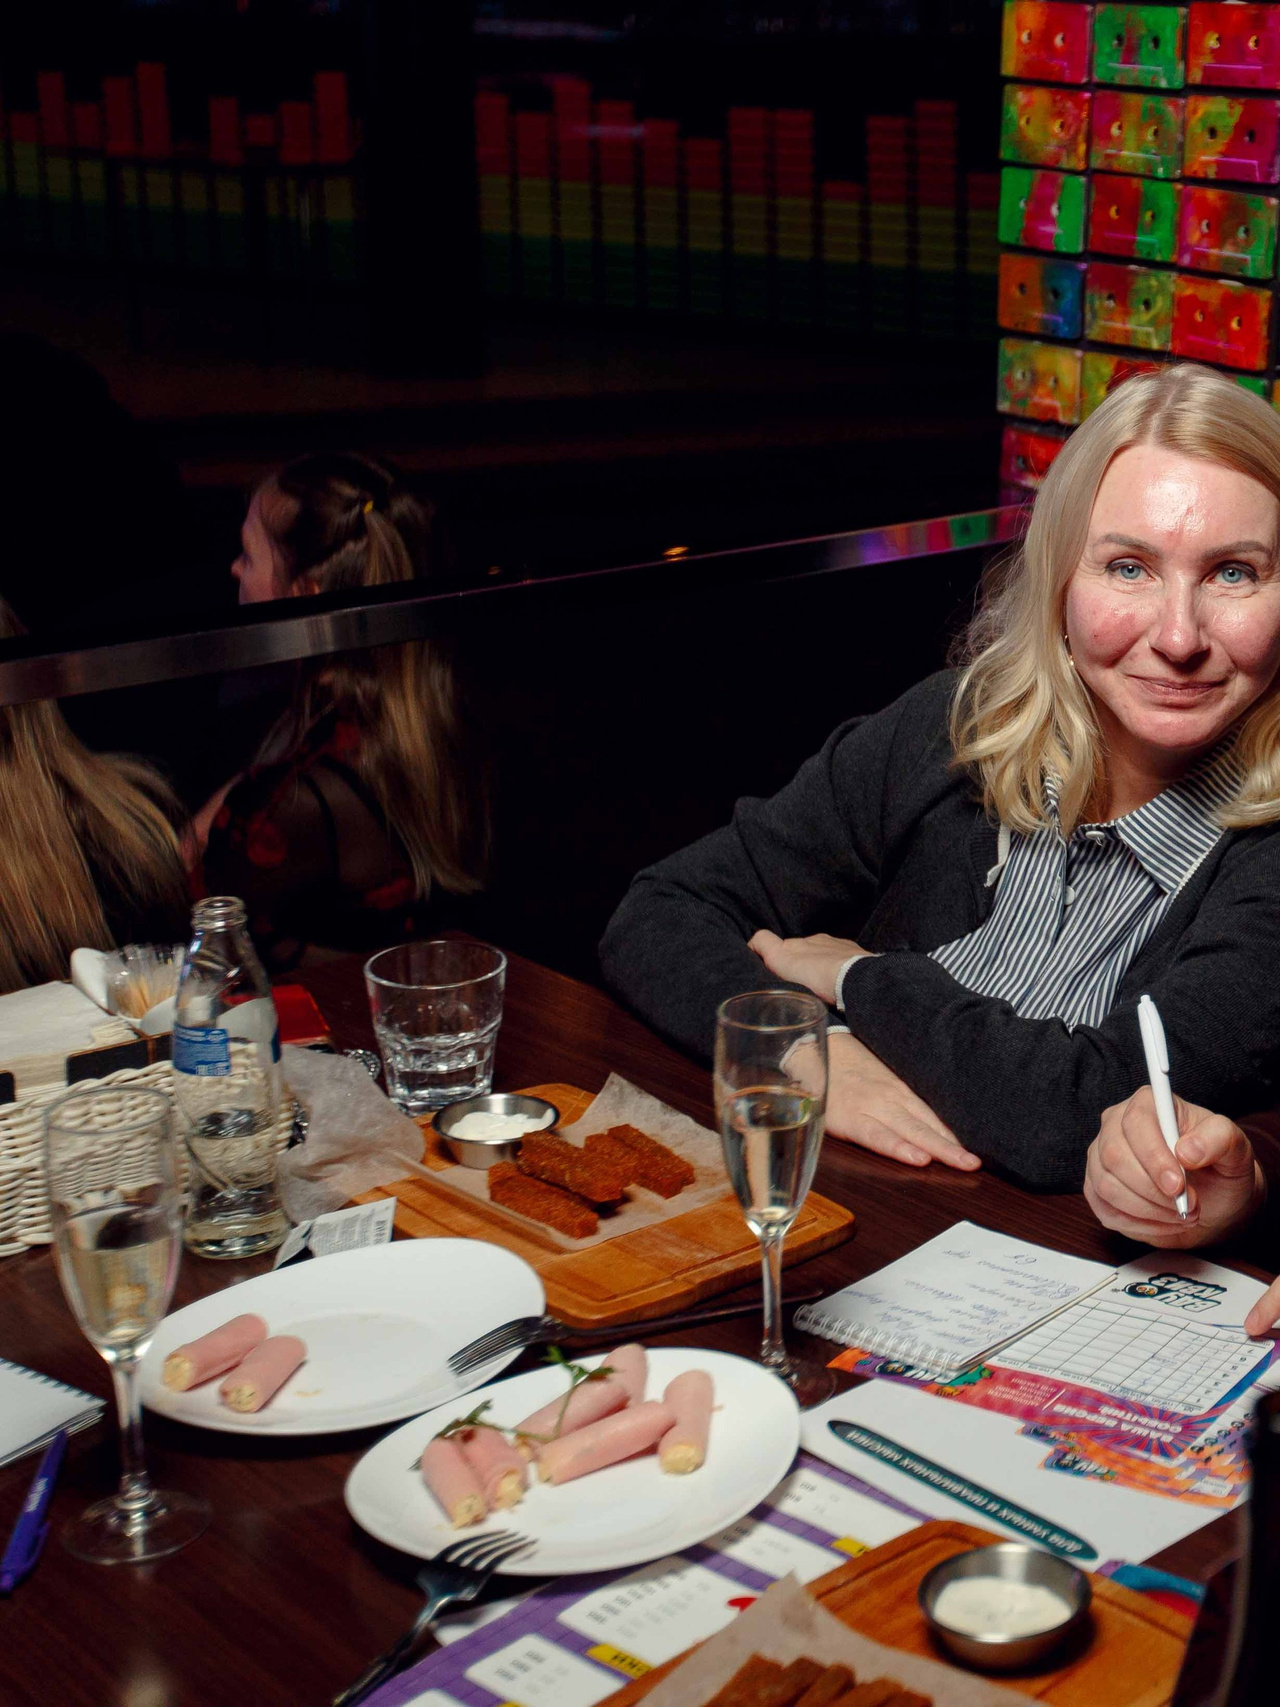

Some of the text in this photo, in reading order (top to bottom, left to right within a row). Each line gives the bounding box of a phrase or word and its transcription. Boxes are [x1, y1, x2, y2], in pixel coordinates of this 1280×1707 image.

[1150, 1276, 1225, 1299] КВИЗ
[1152, 1291, 1222, 1313] ВАУ
[1053, 1403, 1175, 1444] ВАША ВЕРСИЯ
[1098, 1404, 1183, 1434] СОБЫТИЙ:
[845, 1429, 1083, 1553] ДЛЯ УМНЫХ И ПРАВИЛЬНЫХ МЫСЛЕЙ
